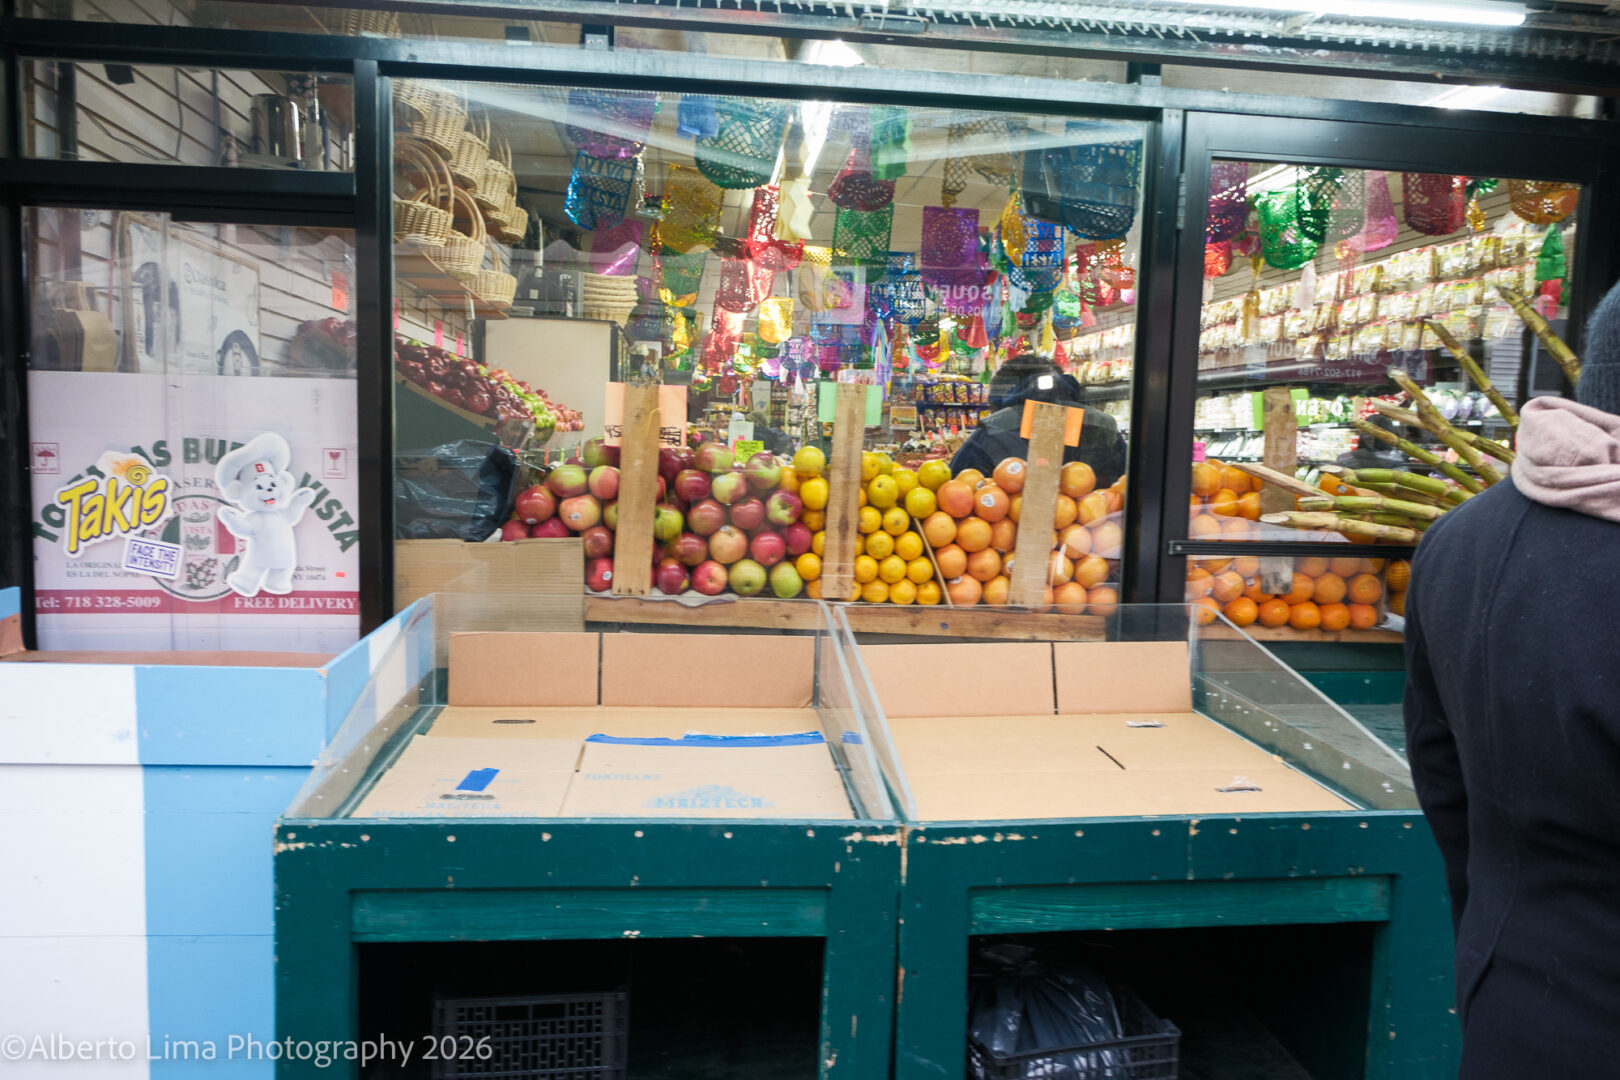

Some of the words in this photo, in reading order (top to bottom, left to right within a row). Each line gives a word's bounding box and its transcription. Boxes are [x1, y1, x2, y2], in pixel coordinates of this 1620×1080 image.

[58, 476, 168, 553] Takis
[132, 543, 154, 558] FACE
[158, 548, 176, 562] THE
[36, 597, 60, 608] Tel:
[65, 597, 91, 608] 718
[95, 597, 160, 608] 328-5009
[234, 597, 275, 609] FREE
[278, 597, 356, 609] DELIVERY
